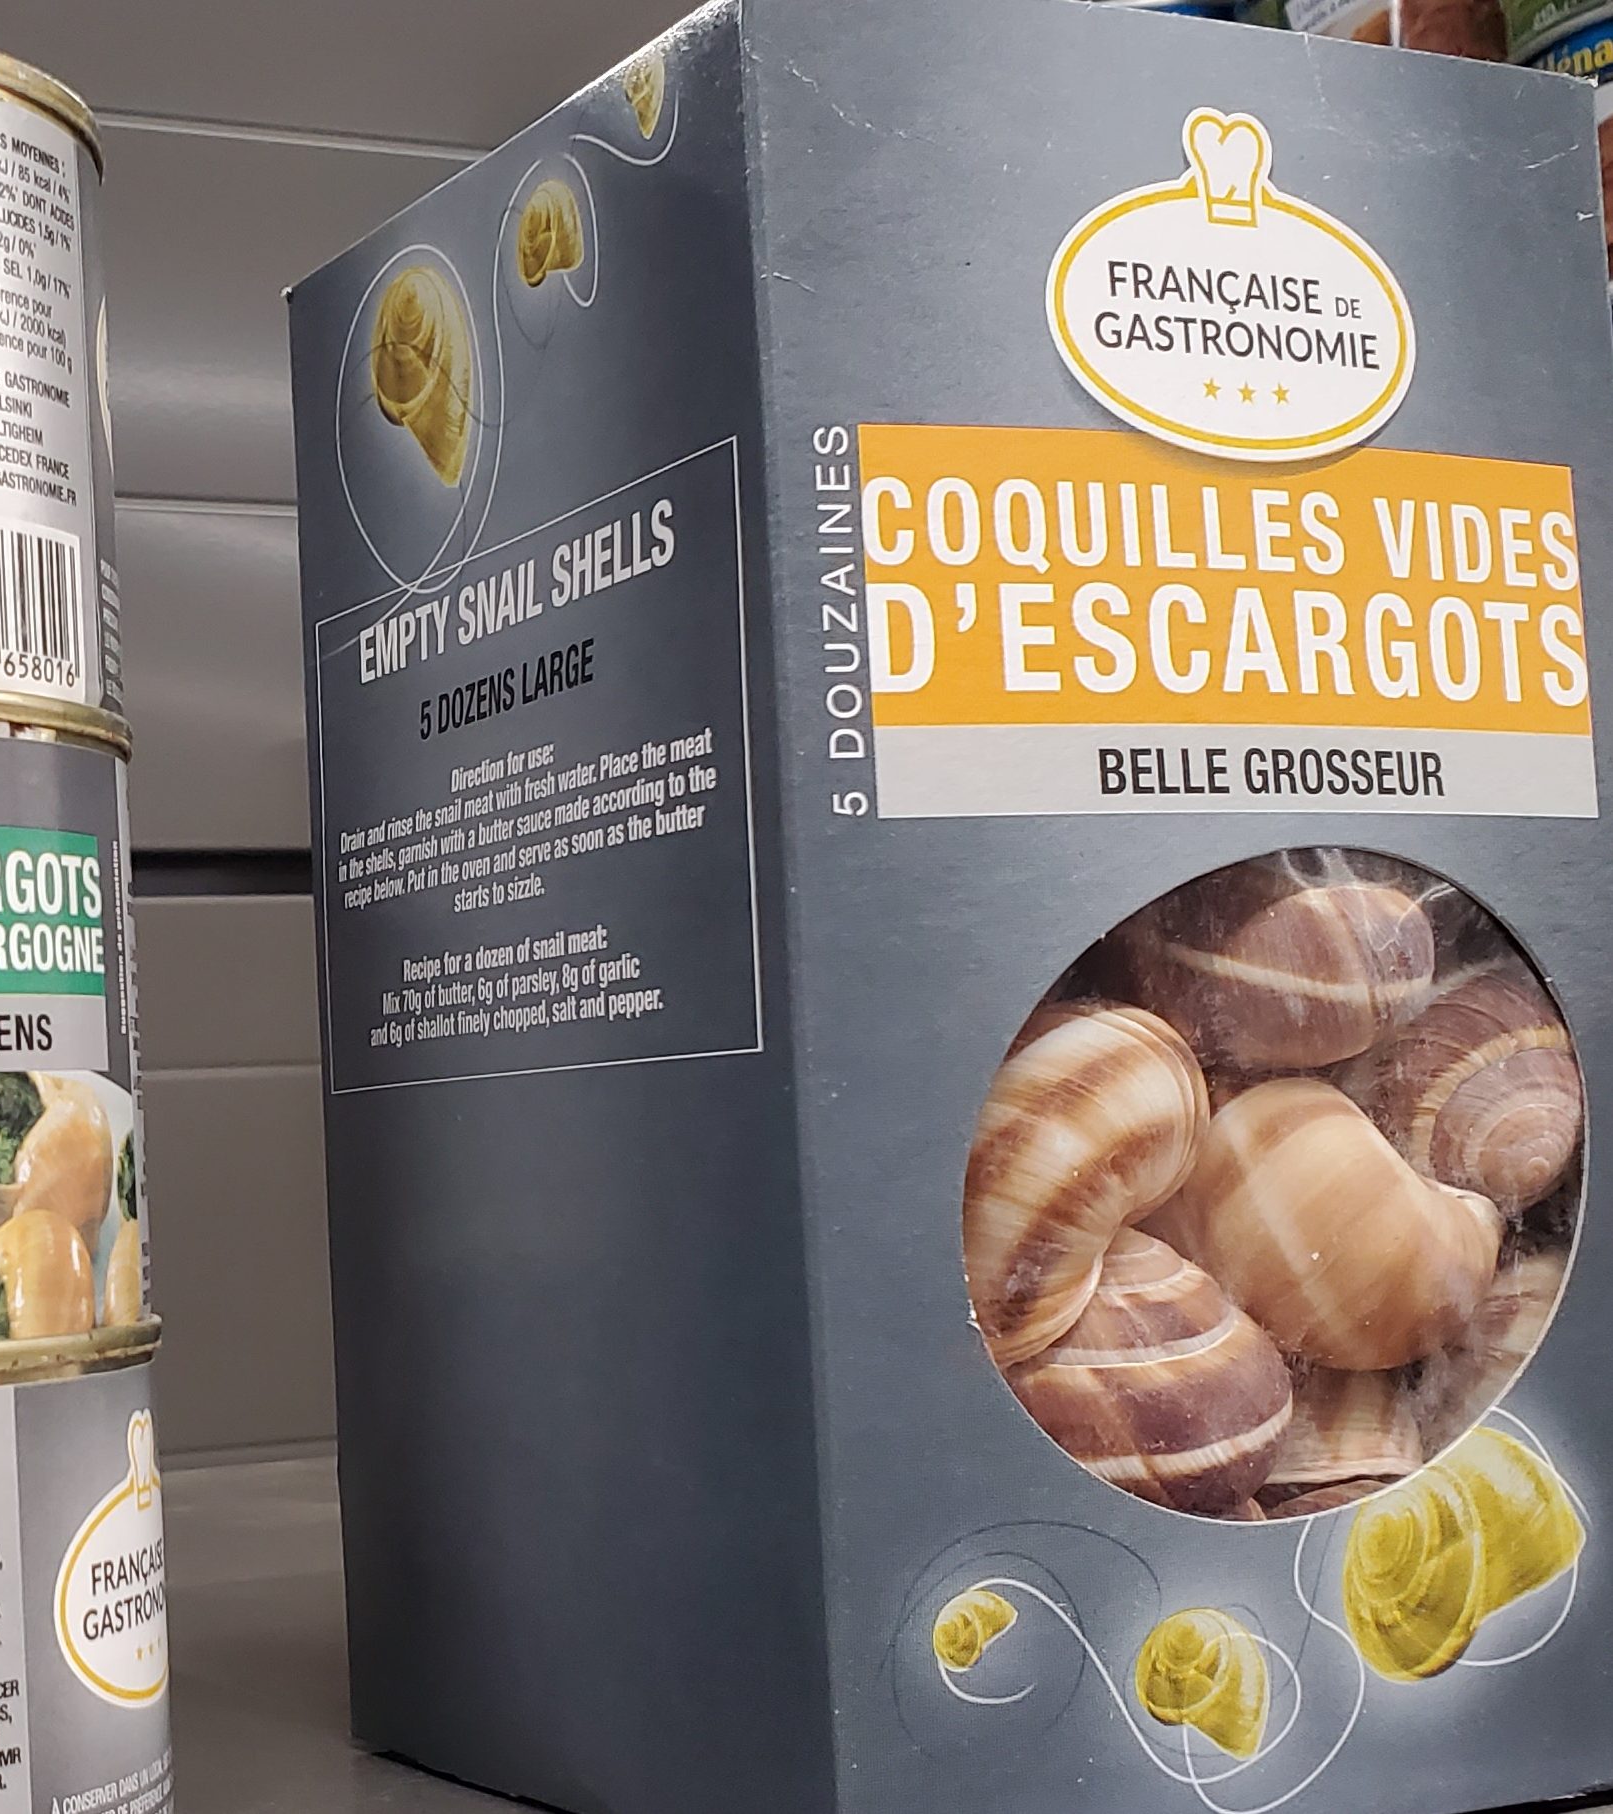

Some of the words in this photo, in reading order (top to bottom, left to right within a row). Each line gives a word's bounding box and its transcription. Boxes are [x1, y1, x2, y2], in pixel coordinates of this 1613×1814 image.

[1107, 261, 1321, 314] FRANÇAISE
[1335, 296, 1361, 319] DE
[1095, 313, 1380, 370] GASTRONOMIE
[4, 370, 70, 408] GASTRONOMIE
[35, 455, 69, 480] FRANCE
[864, 476, 1344, 574] COQUILLES
[1373, 497, 1578, 590] VIDES
[360, 595, 449, 684] EMPTY
[457, 559, 542, 645] SNAIL
[551, 499, 675, 606] SHELLS
[813, 425, 865, 758] DOUZAINES
[4, 652, 75, 688] 658016
[869, 583, 1588, 706] D'ESCARGOTS
[419, 698, 431, 740] 5
[438, 668, 515, 735] DOZENS
[522, 638, 594, 705] LARGE
[340, 827, 365, 853] Drain
[367, 819, 386, 845] and
[387, 816, 413, 840] rinse
[415, 808, 432, 832] the
[434, 797, 461, 826] snail
[463, 789, 493, 819] meat
[495, 781, 521, 810] with
[524, 772, 555, 802] fresh
[557, 763, 597, 792] water.
[599, 751, 638, 780] Place
[641, 743, 666, 769] the
[670, 727, 712, 762] meat
[451, 758, 504, 792] Direction
[506, 752, 525, 776] for
[527, 743, 554, 769] use:
[1099, 748, 1228, 796] BELLE
[1244, 750, 1445, 796] GROSSEUR
[833, 791, 868, 816] 5
[403, 955, 441, 984] Recipe
[443, 951, 461, 975] for
[464, 952, 472, 971] a
[475, 945, 513, 970] dozen
[516, 936, 530, 963] of
[533, 930, 564, 960] snail
[567, 924, 607, 954] meat:
[382, 991, 400, 1015] Mix
[402, 988, 421, 1015] 70g
[424, 983, 435, 1008] of
[437, 980, 475, 1006] butter,
[477, 976, 493, 1005] 6g
[496, 972, 509, 998] of
[511, 967, 559, 1001] parsley,
[561, 963, 578, 992] 8g
[581, 960, 595, 985] of
[598, 954, 640, 988] garlic
[83, 1582, 163, 1640] GASTRONO
